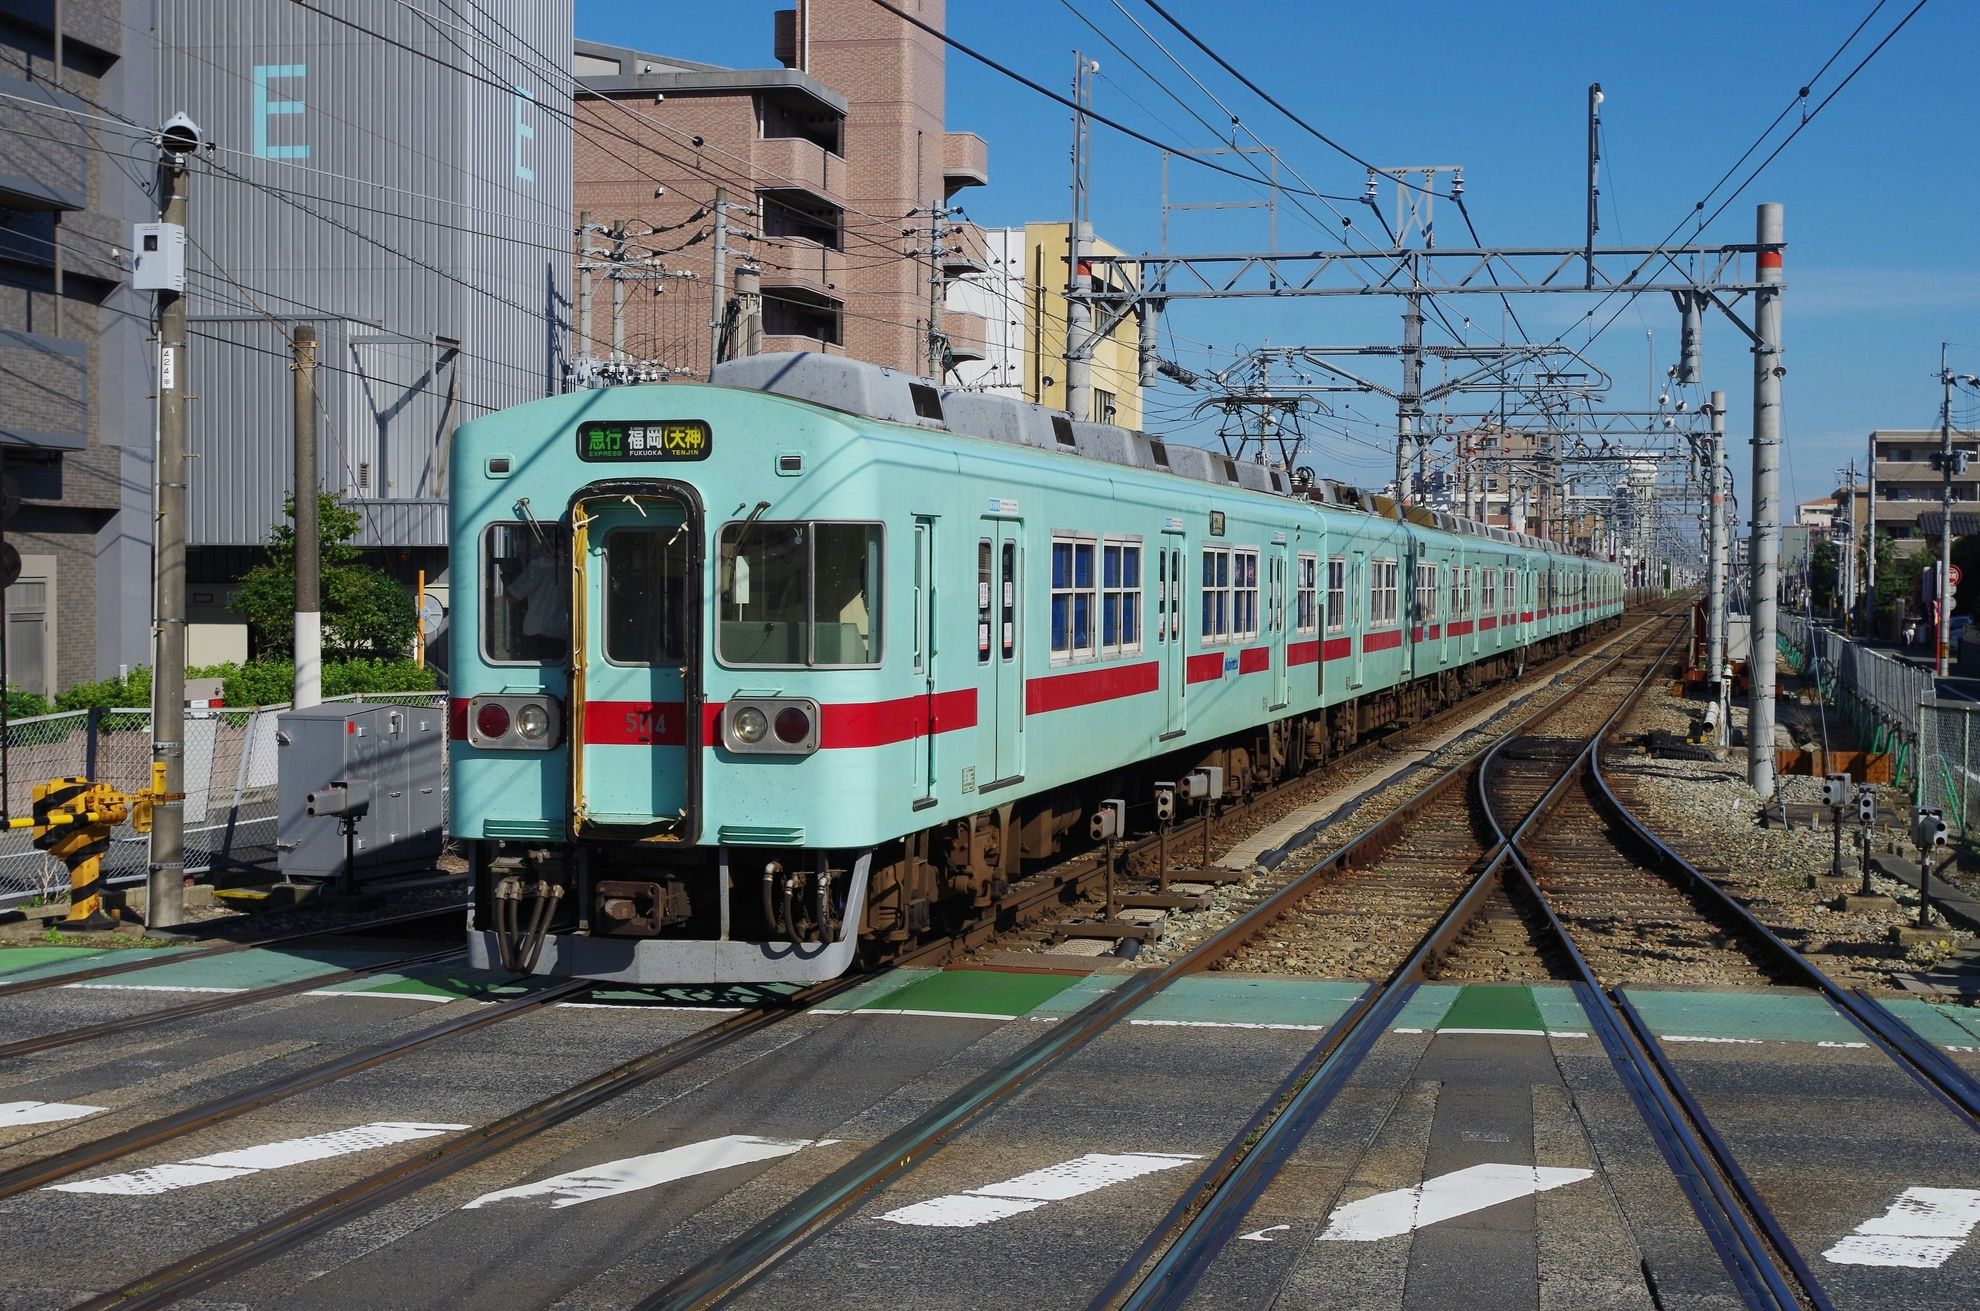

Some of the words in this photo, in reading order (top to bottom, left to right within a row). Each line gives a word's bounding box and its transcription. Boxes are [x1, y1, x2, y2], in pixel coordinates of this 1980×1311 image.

[253, 64, 310, 159] E
[514, 85, 535, 182] E
[589, 427, 622, 450] 急行
[628, 426, 662, 449] 福岡
[664, 425, 705, 449] (天神)
